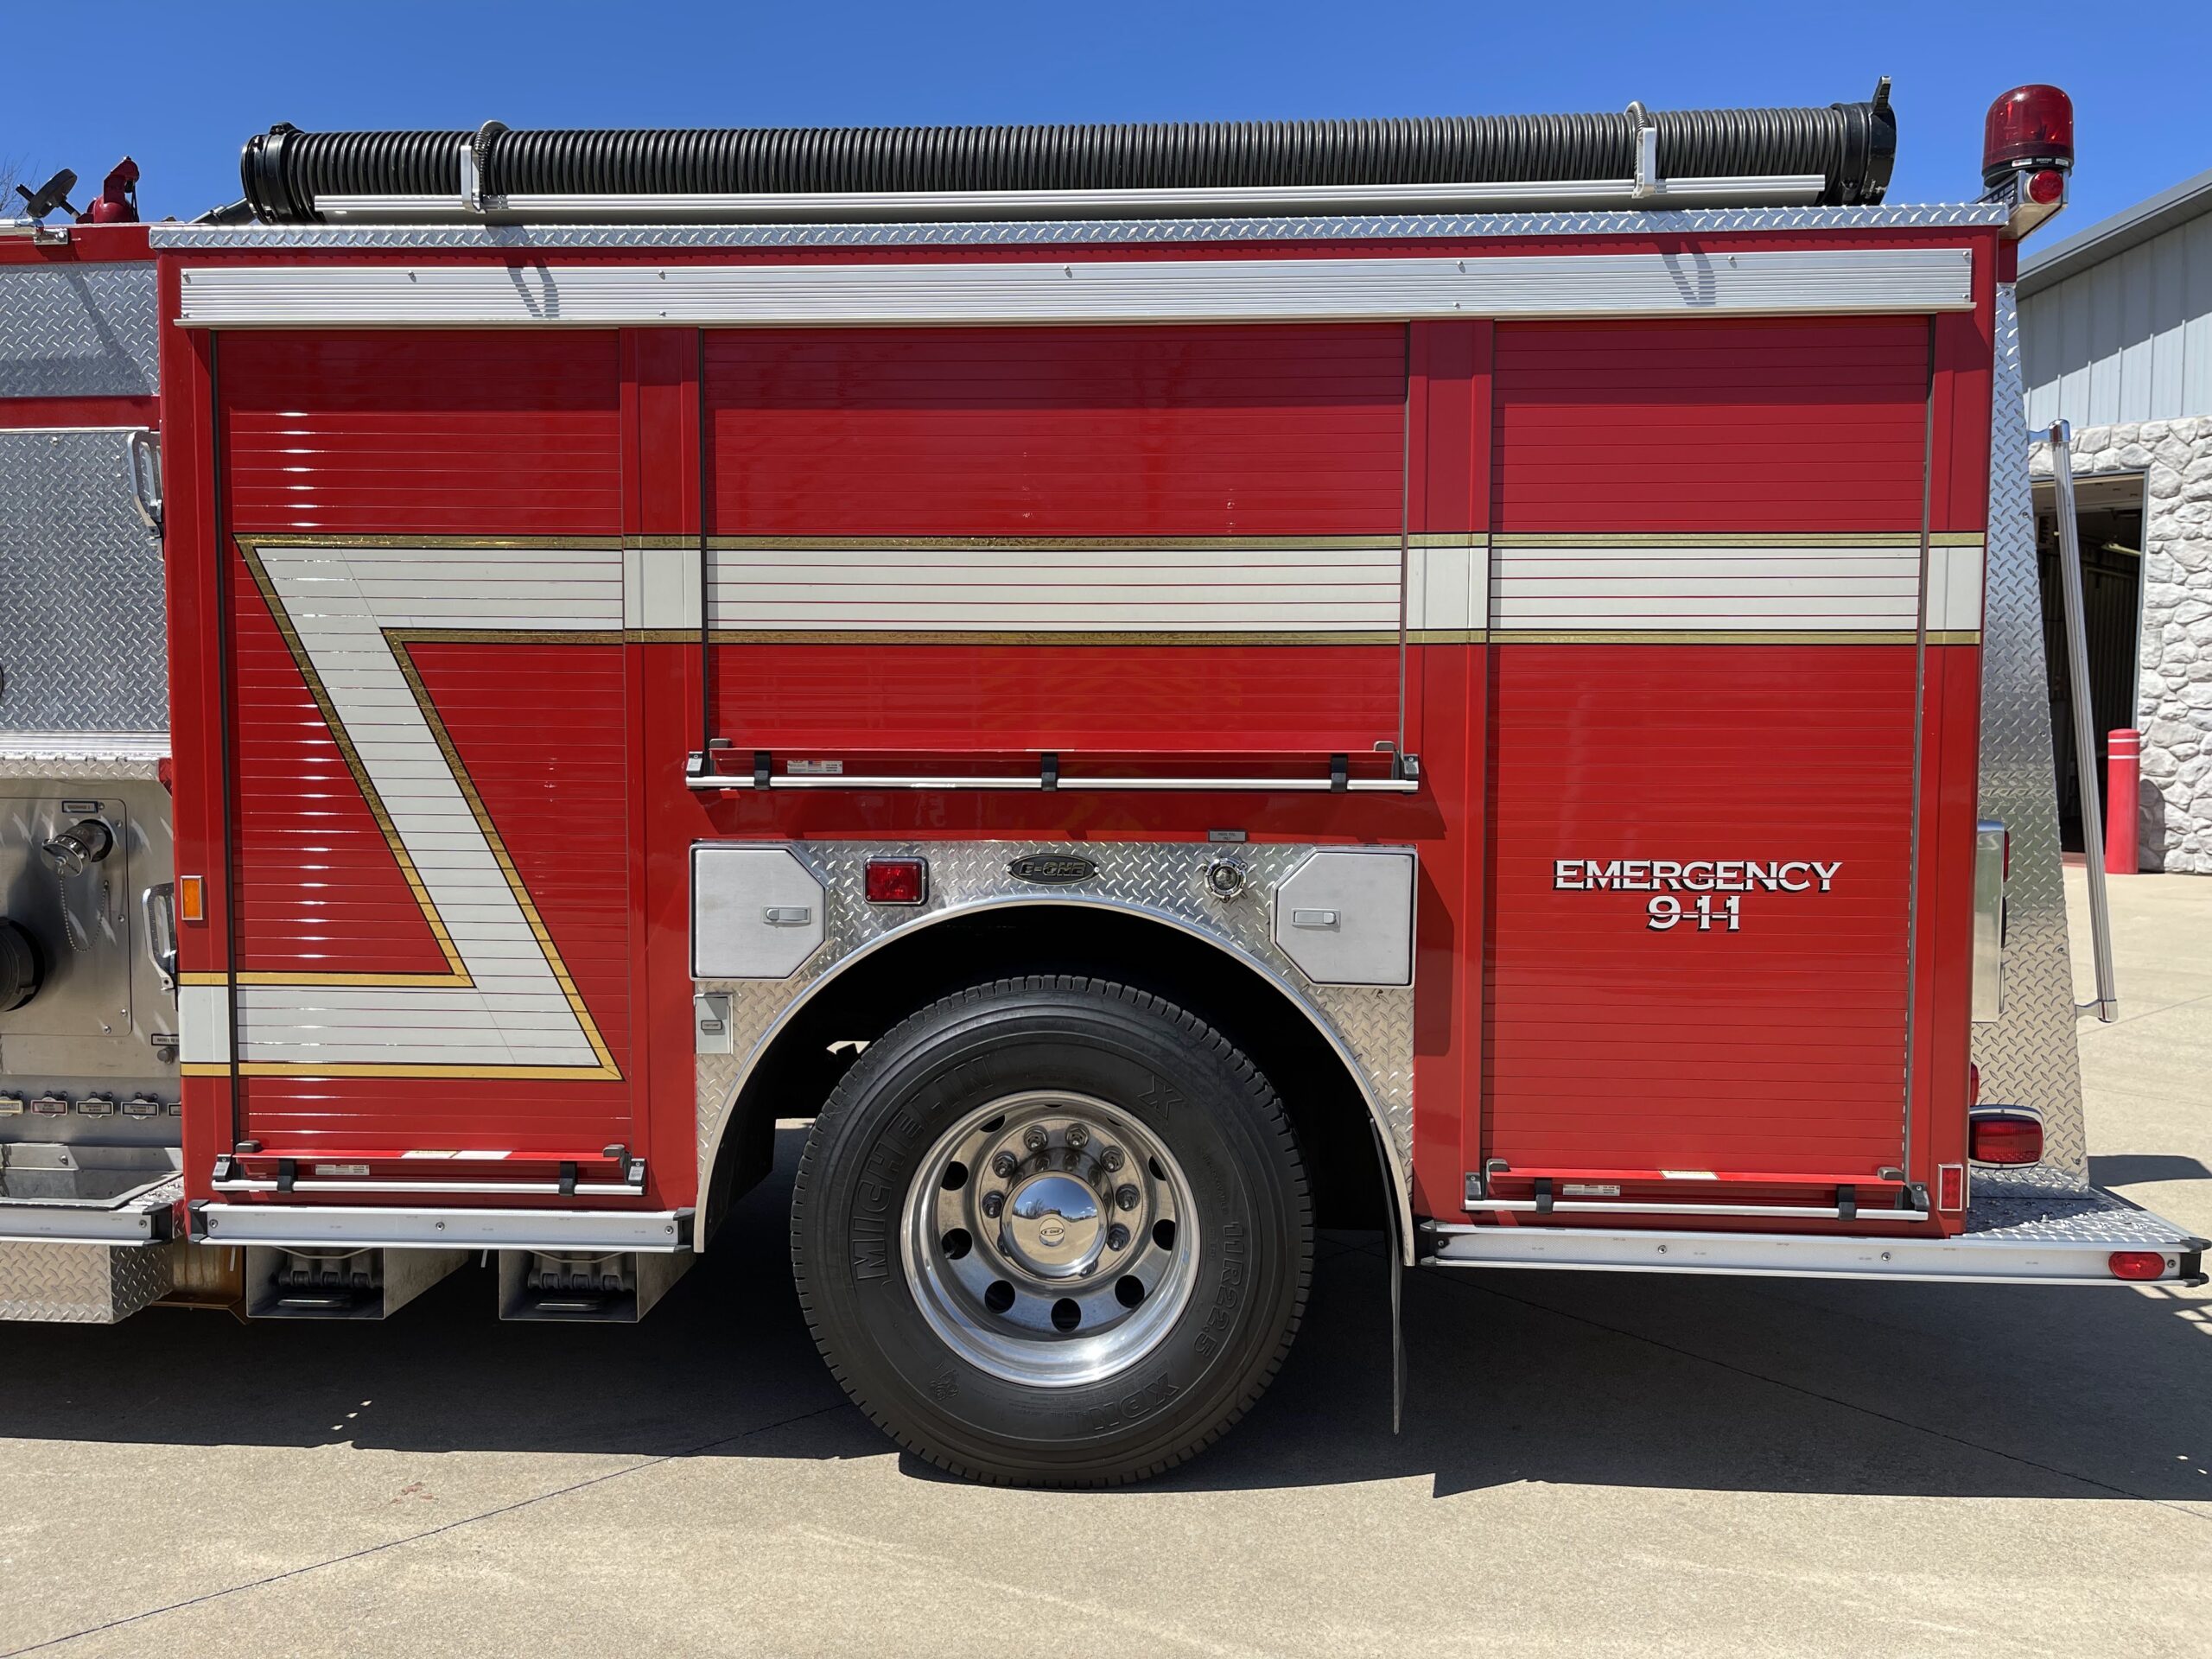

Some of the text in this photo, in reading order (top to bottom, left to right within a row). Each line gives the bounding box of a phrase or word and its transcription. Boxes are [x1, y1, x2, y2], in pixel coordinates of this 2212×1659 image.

[1019, 861, 1087, 877] E-ONE
[1553, 859, 1843, 893] EMERGENCY
[852, 1055, 995, 1281] MICHELIN
[1193, 1221, 1244, 1357] 11R22.5
